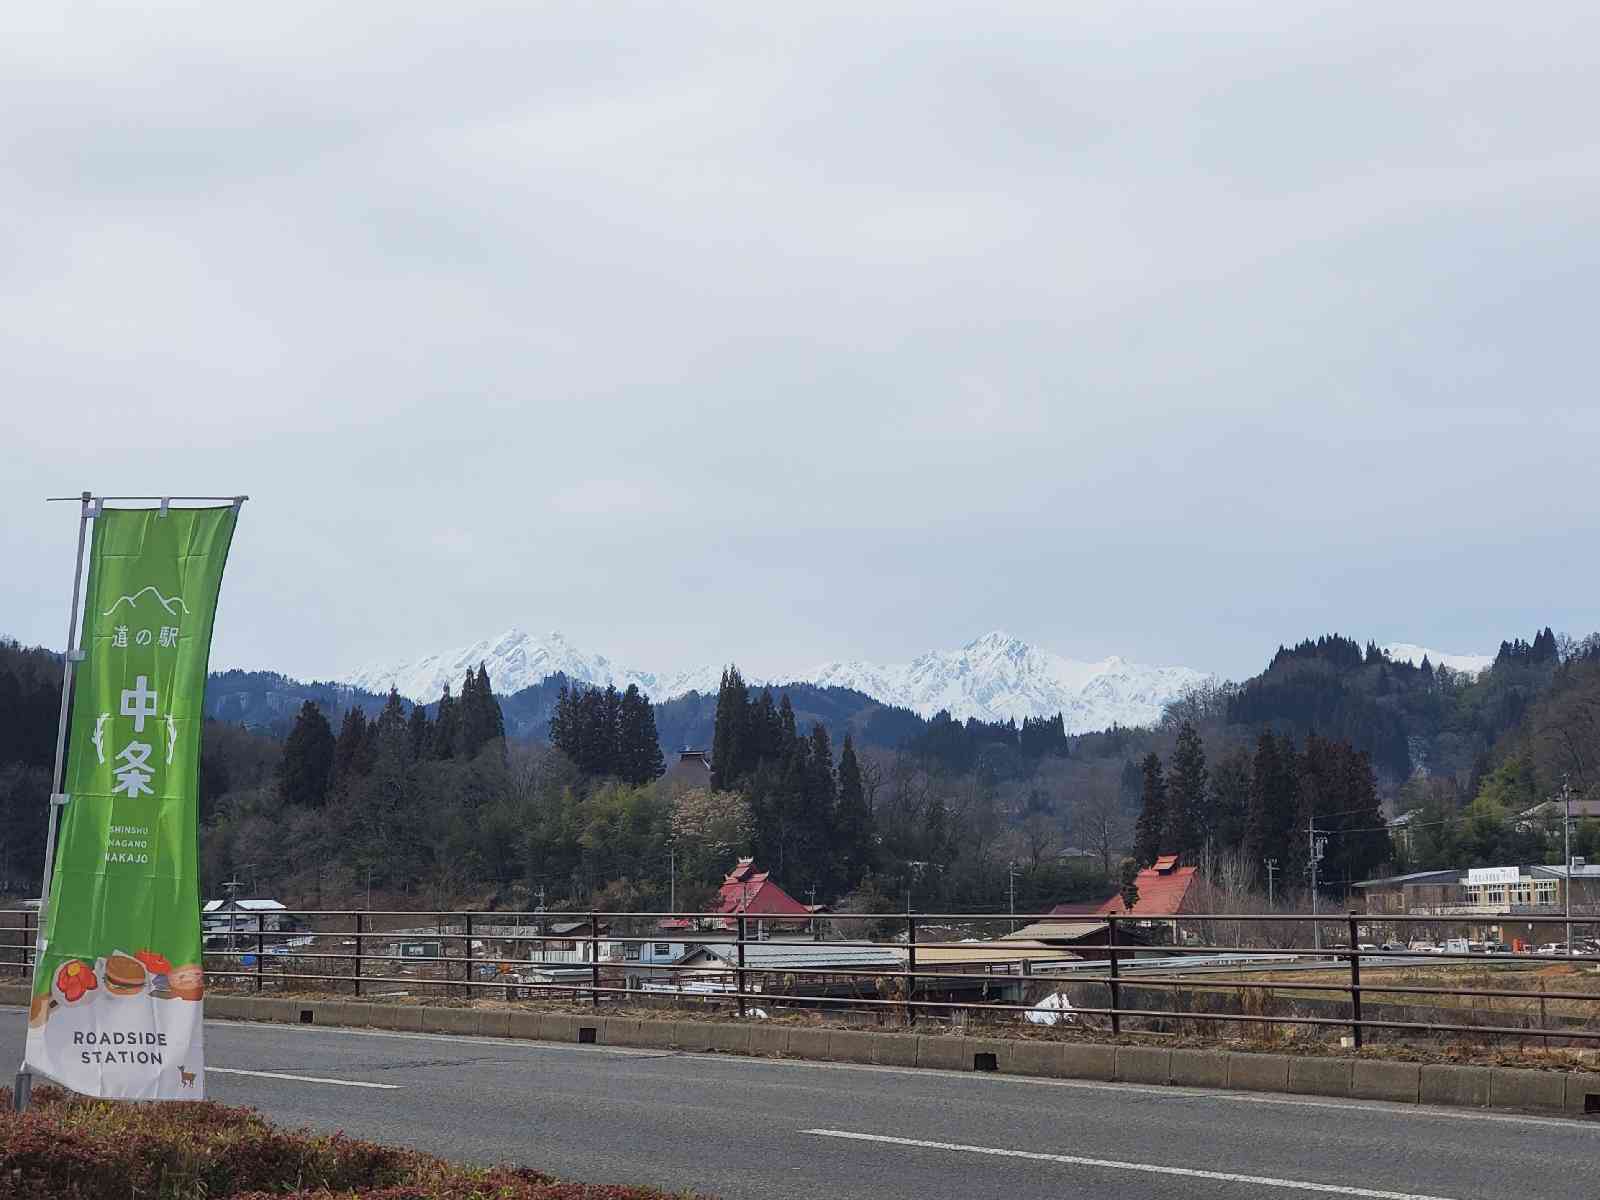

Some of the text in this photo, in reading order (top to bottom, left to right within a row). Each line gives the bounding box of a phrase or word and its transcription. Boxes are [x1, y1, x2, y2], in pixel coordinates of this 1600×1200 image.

[112, 624, 179, 648] 道の駅
[112, 675, 157, 798] 中条
[73, 1031, 167, 1046] ROADSIDE
[81, 1051, 163, 1065] STATION
